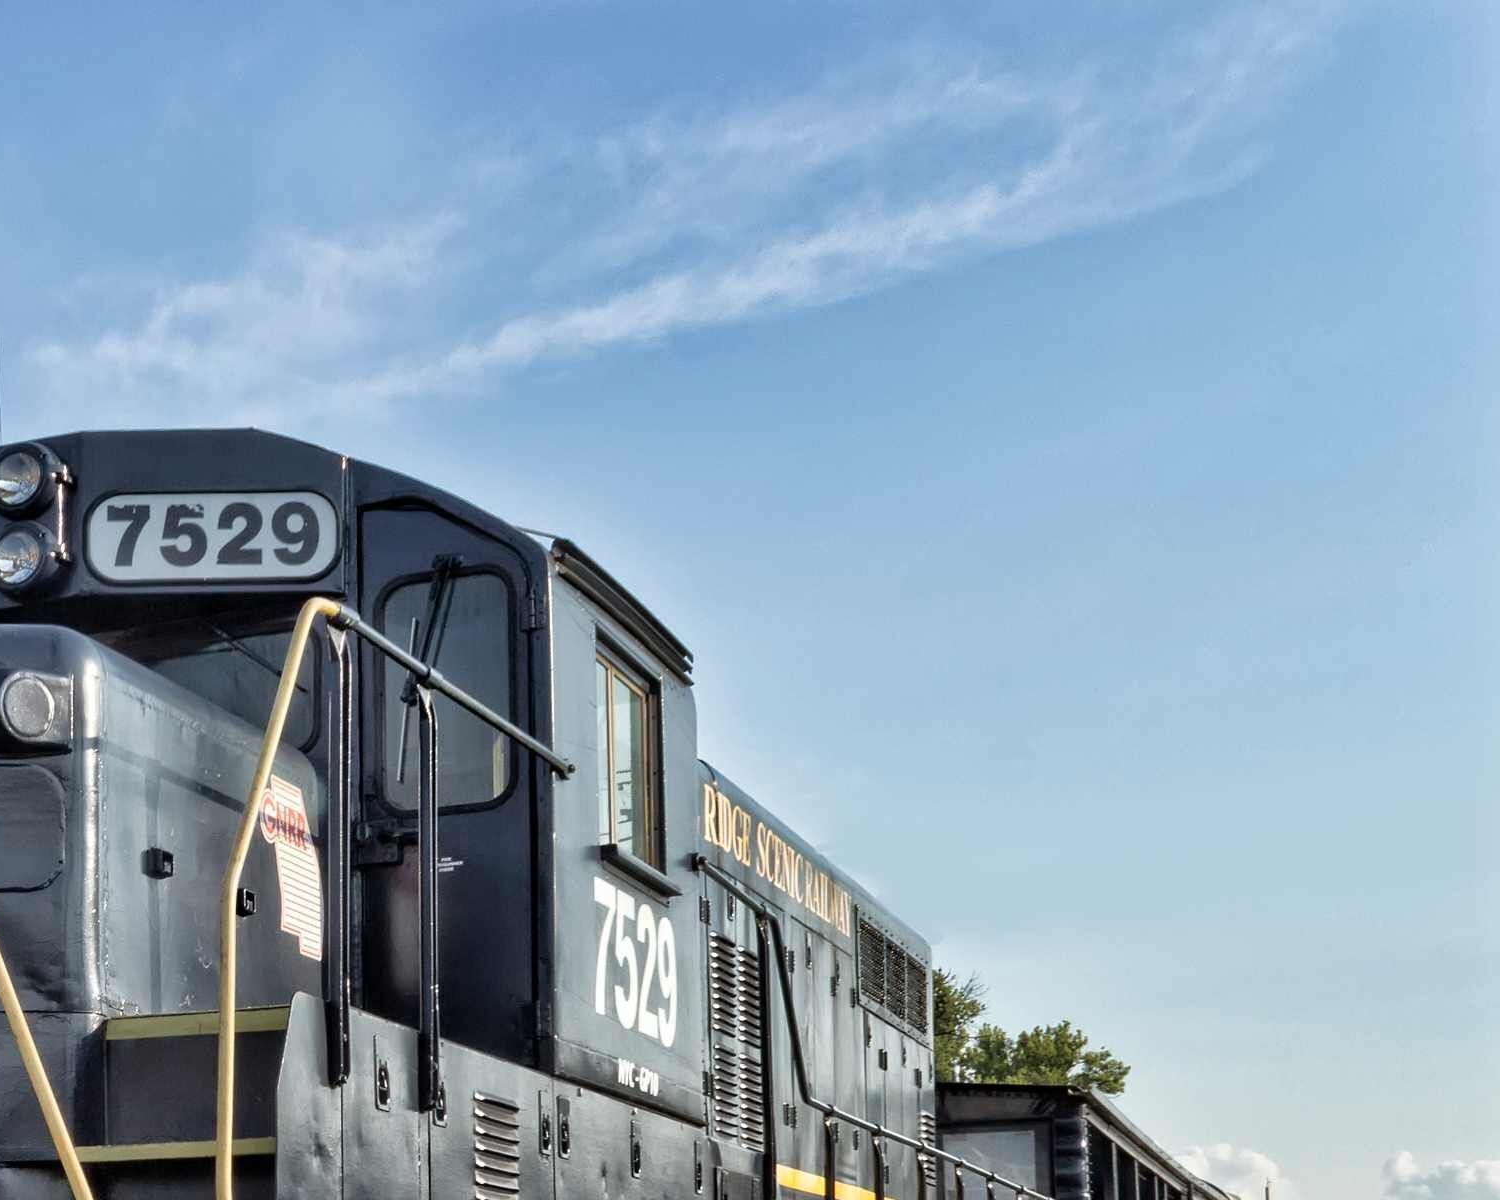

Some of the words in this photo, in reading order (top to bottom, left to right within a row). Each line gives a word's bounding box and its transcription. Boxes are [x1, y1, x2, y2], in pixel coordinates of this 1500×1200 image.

[106, 502, 321, 567] 7529
[704, 783, 751, 867] RIDGE
[756, 822, 804, 904] SCENIC
[804, 858, 851, 938] RAILWAY
[593, 876, 677, 1048] 7529
